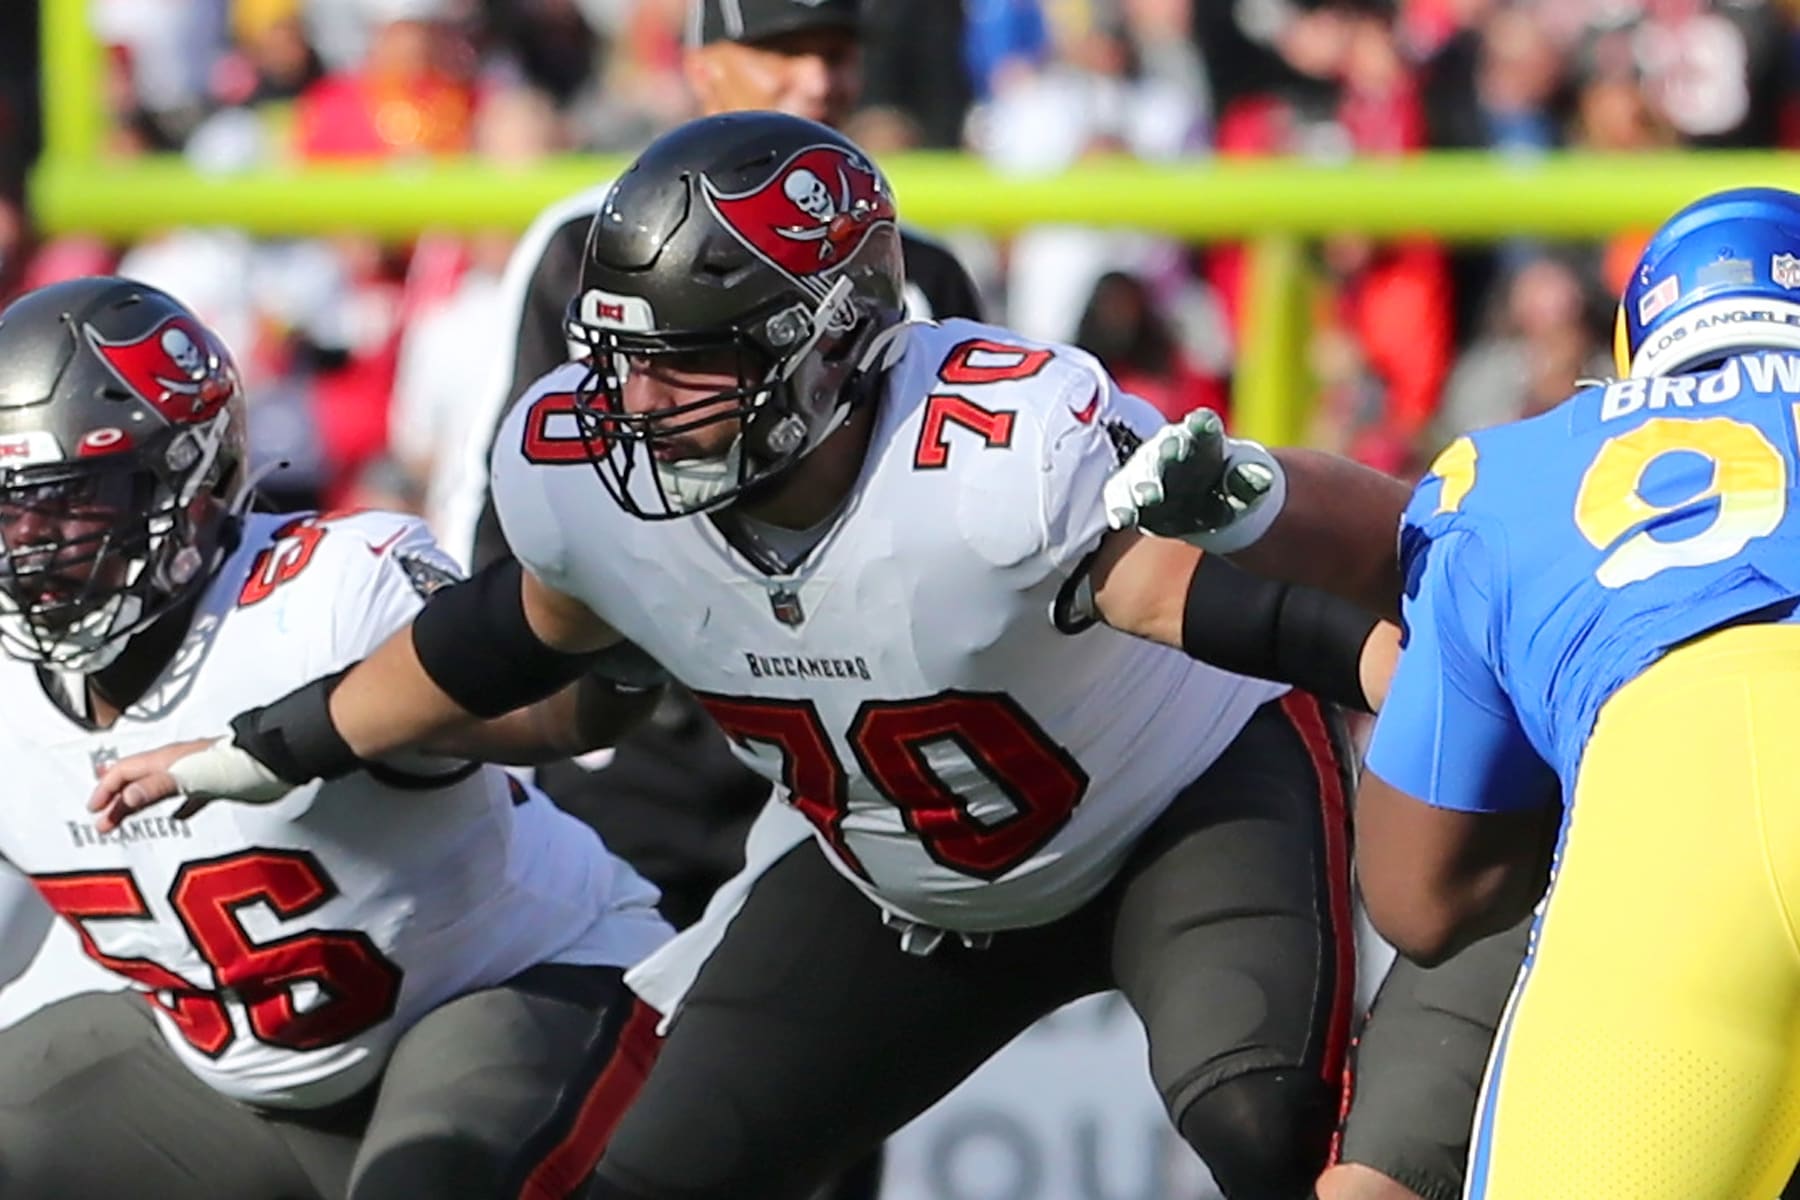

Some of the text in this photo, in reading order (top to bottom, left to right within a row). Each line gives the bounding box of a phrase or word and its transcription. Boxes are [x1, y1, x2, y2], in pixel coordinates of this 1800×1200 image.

[913, 338, 1056, 471] 70
[1647, 327, 1687, 359] LOS
[745, 652, 872, 680] BUCCANEERS
[694, 689, 1089, 882] 70
[28, 846, 404, 1060] 56
